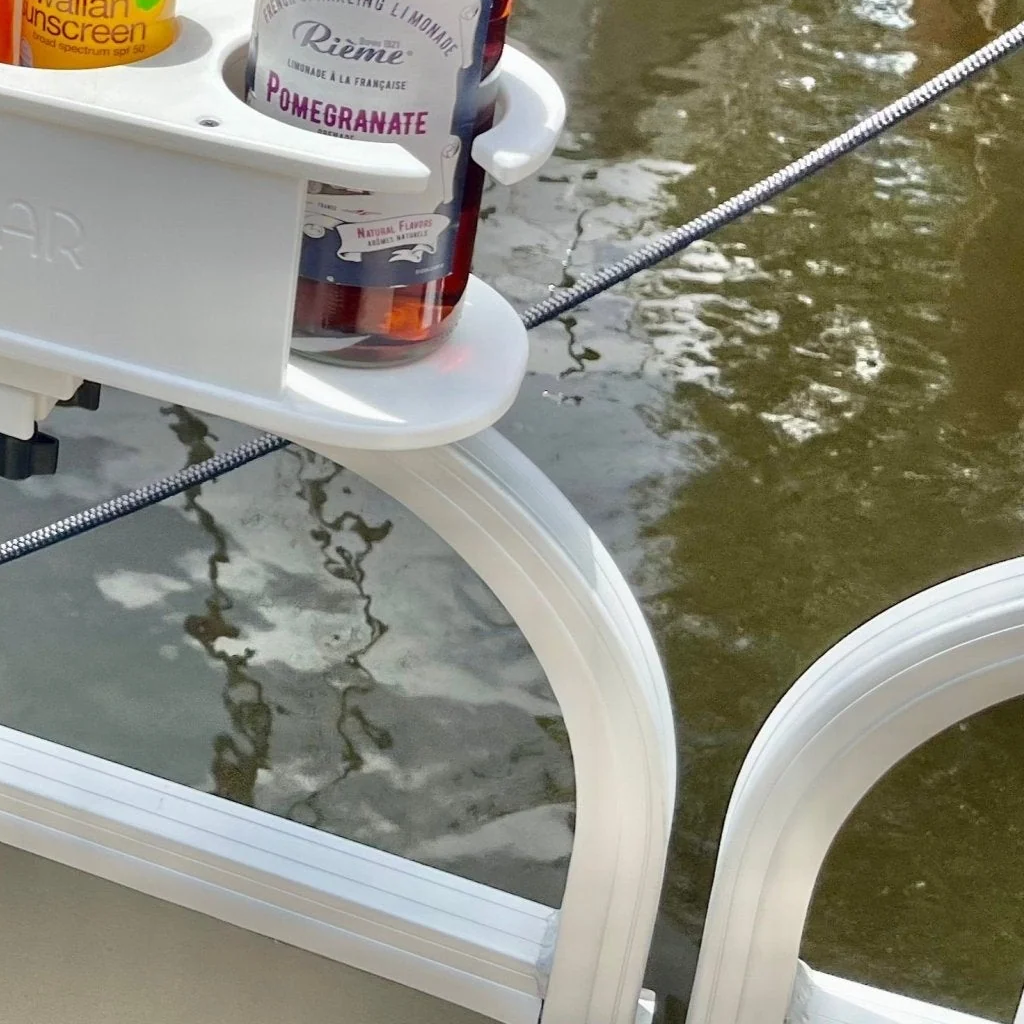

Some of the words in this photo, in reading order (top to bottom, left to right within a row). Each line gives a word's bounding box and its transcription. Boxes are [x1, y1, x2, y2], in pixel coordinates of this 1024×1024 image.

[58, 42, 110, 56] spectrum
[113, 47, 130, 56] spf
[292, 20, 404, 65] Rième
[390, 2, 458, 57] LIMONADE
[287, 58, 327, 80] LIMONADE
[339, 74, 351, 85] LA
[354, 77, 407, 91] FRANÇAISE
[266, 69, 429, 135] POMEGRANATE
[356, 225, 395, 239] NATURAL
[399, 218, 433, 232] FLAVORS
